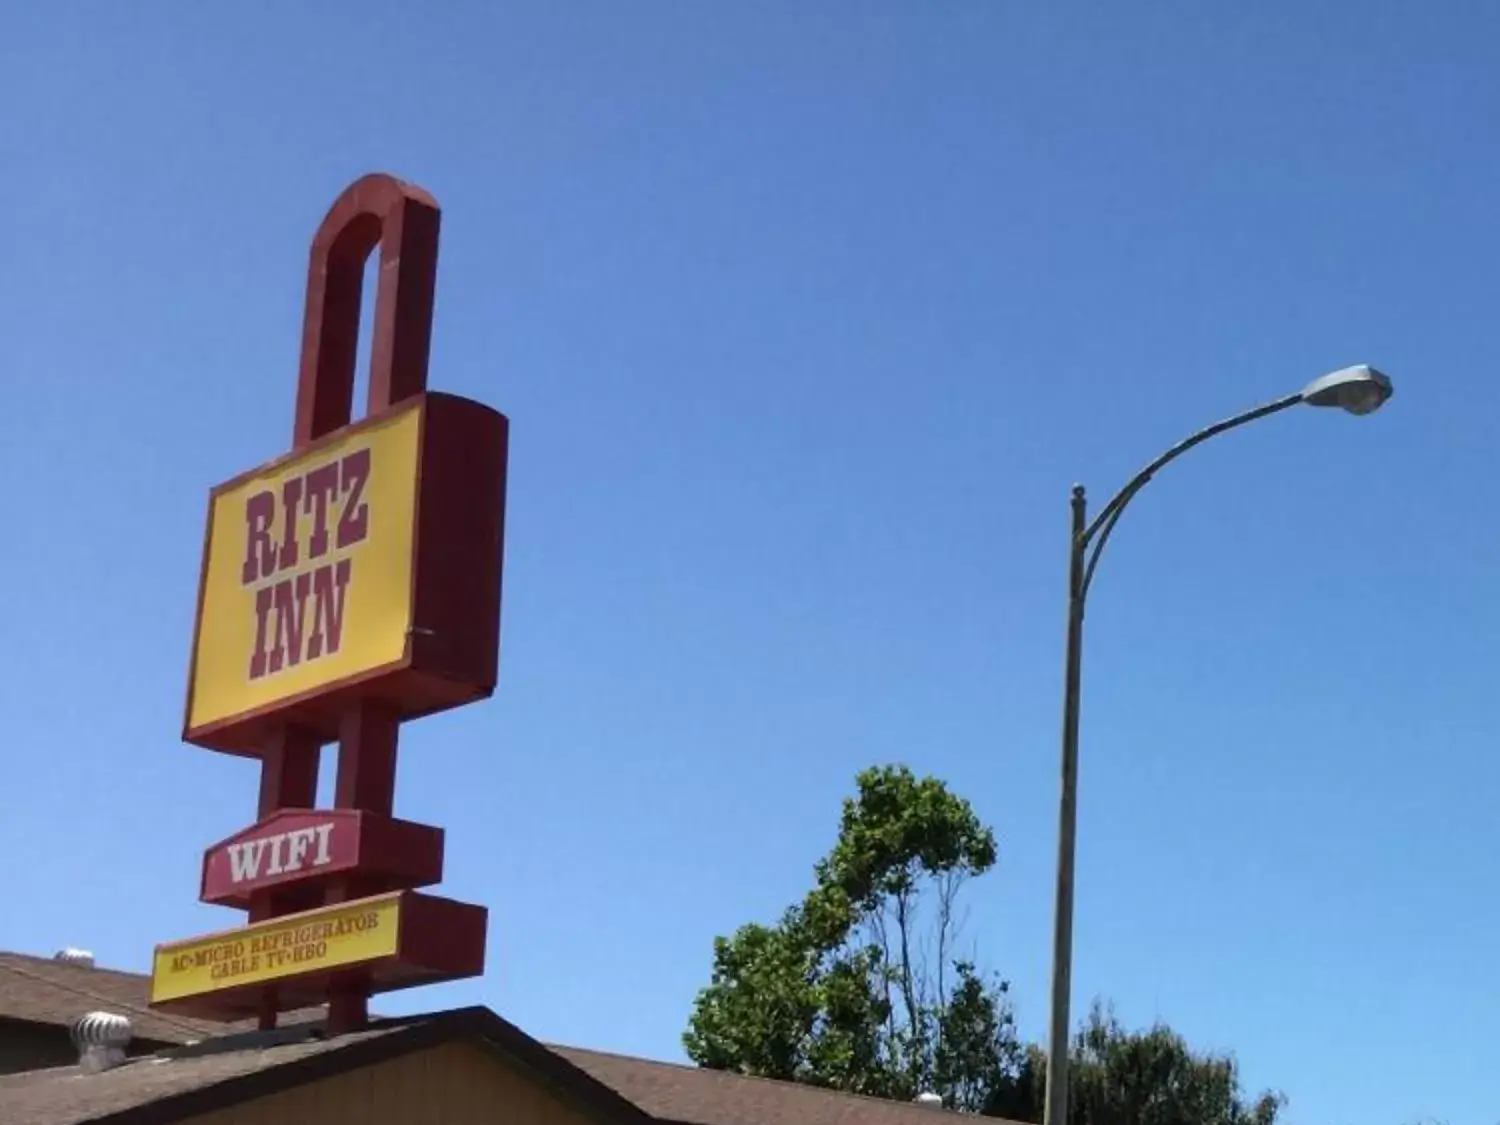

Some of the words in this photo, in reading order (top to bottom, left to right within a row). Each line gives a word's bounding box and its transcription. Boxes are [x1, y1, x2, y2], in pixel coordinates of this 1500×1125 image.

[242, 447, 371, 586] RITZ
[249, 557, 352, 681] INN
[227, 823, 335, 883] WIFI
[250, 911, 380, 953] REFRIGERATOR
[210, 956, 260, 980] CABLE
